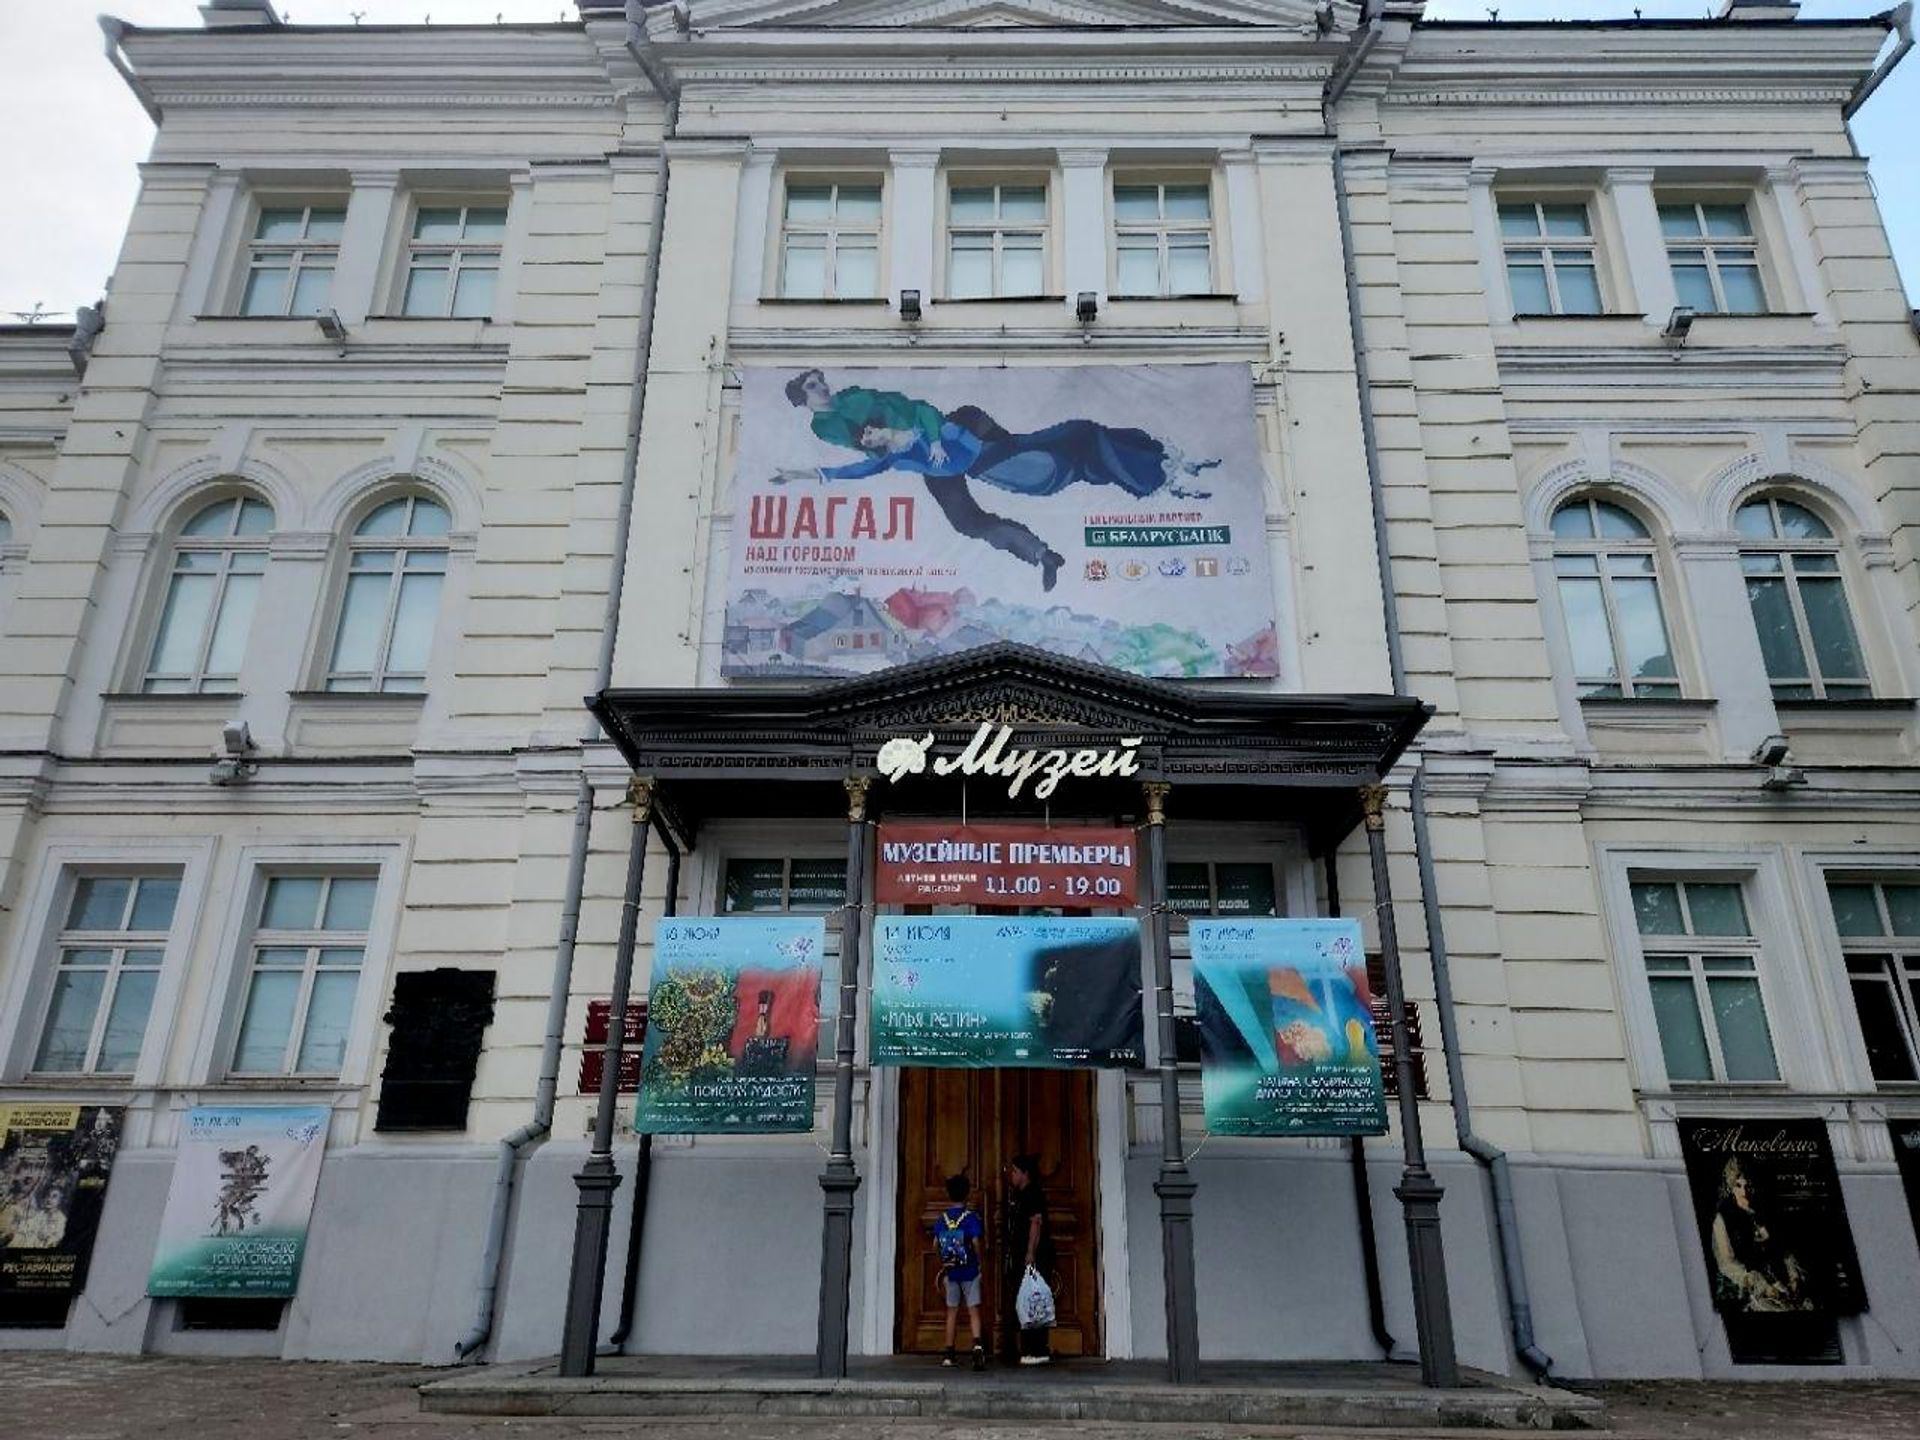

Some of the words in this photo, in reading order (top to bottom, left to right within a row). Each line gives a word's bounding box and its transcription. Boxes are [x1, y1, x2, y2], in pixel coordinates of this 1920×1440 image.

[750, 495, 915, 541] ШАГАЛ
[746, 546, 778, 561] НАД
[783, 546, 856, 562] ГОРОДОМ
[933, 721, 1143, 799] Музей
[882, 839, 1002, 864] МУЗЕЙНЫЕ
[1009, 843, 1131, 867] ПРЕМЬЕРЫ
[985, 876, 1041, 894] 11.00
[1065, 876, 1121, 896] 19.00
